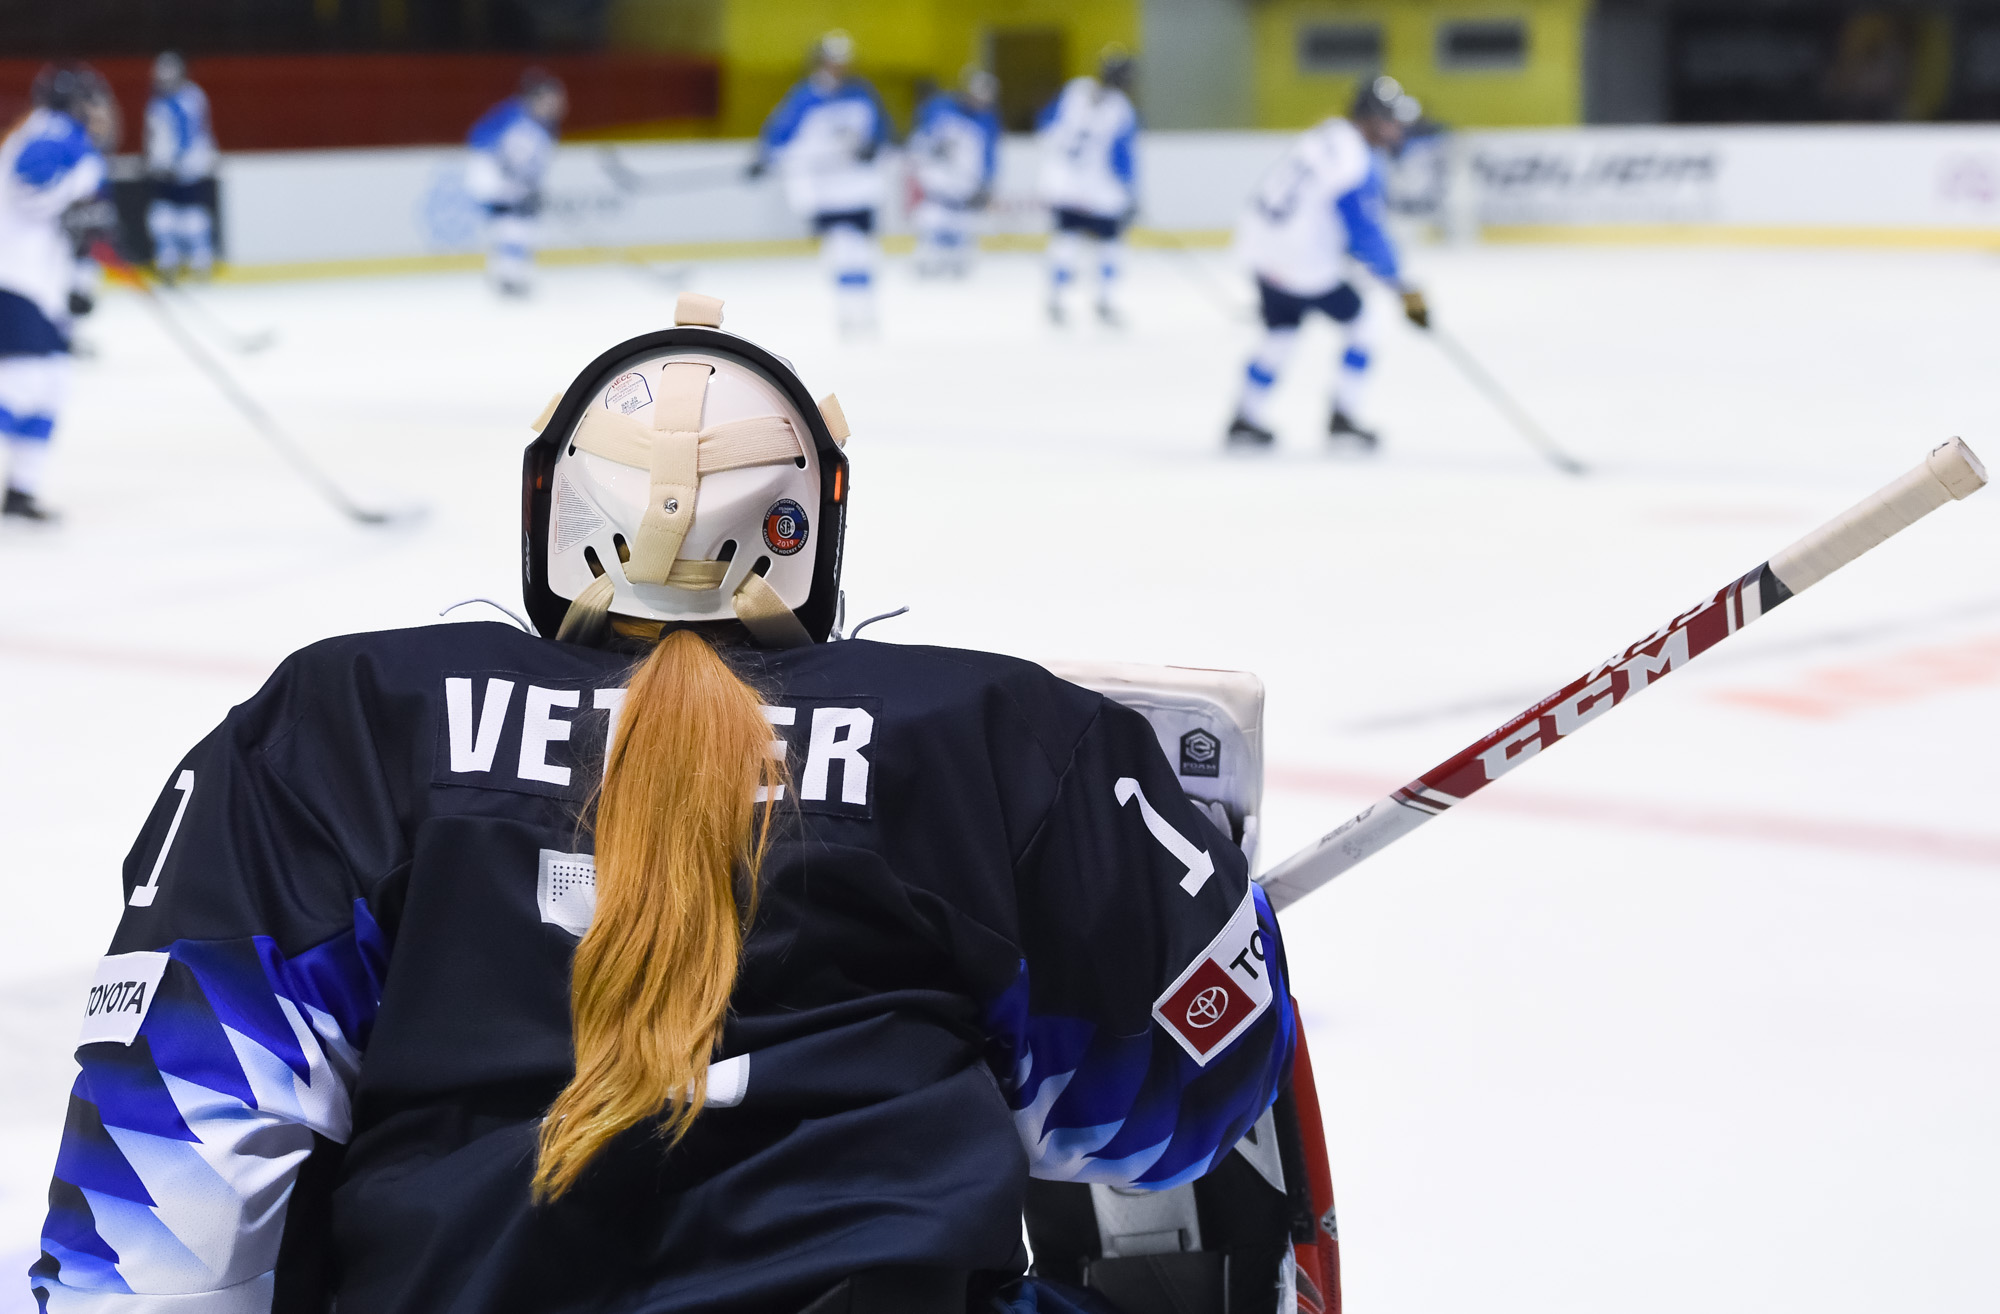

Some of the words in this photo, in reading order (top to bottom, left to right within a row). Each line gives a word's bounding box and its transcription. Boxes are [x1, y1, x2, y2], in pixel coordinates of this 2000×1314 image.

[1476, 626, 1689, 780] CCM
[129, 769, 195, 907] 1
[1114, 777, 1215, 898] 1
[84, 981, 147, 1020] TOYOTA
